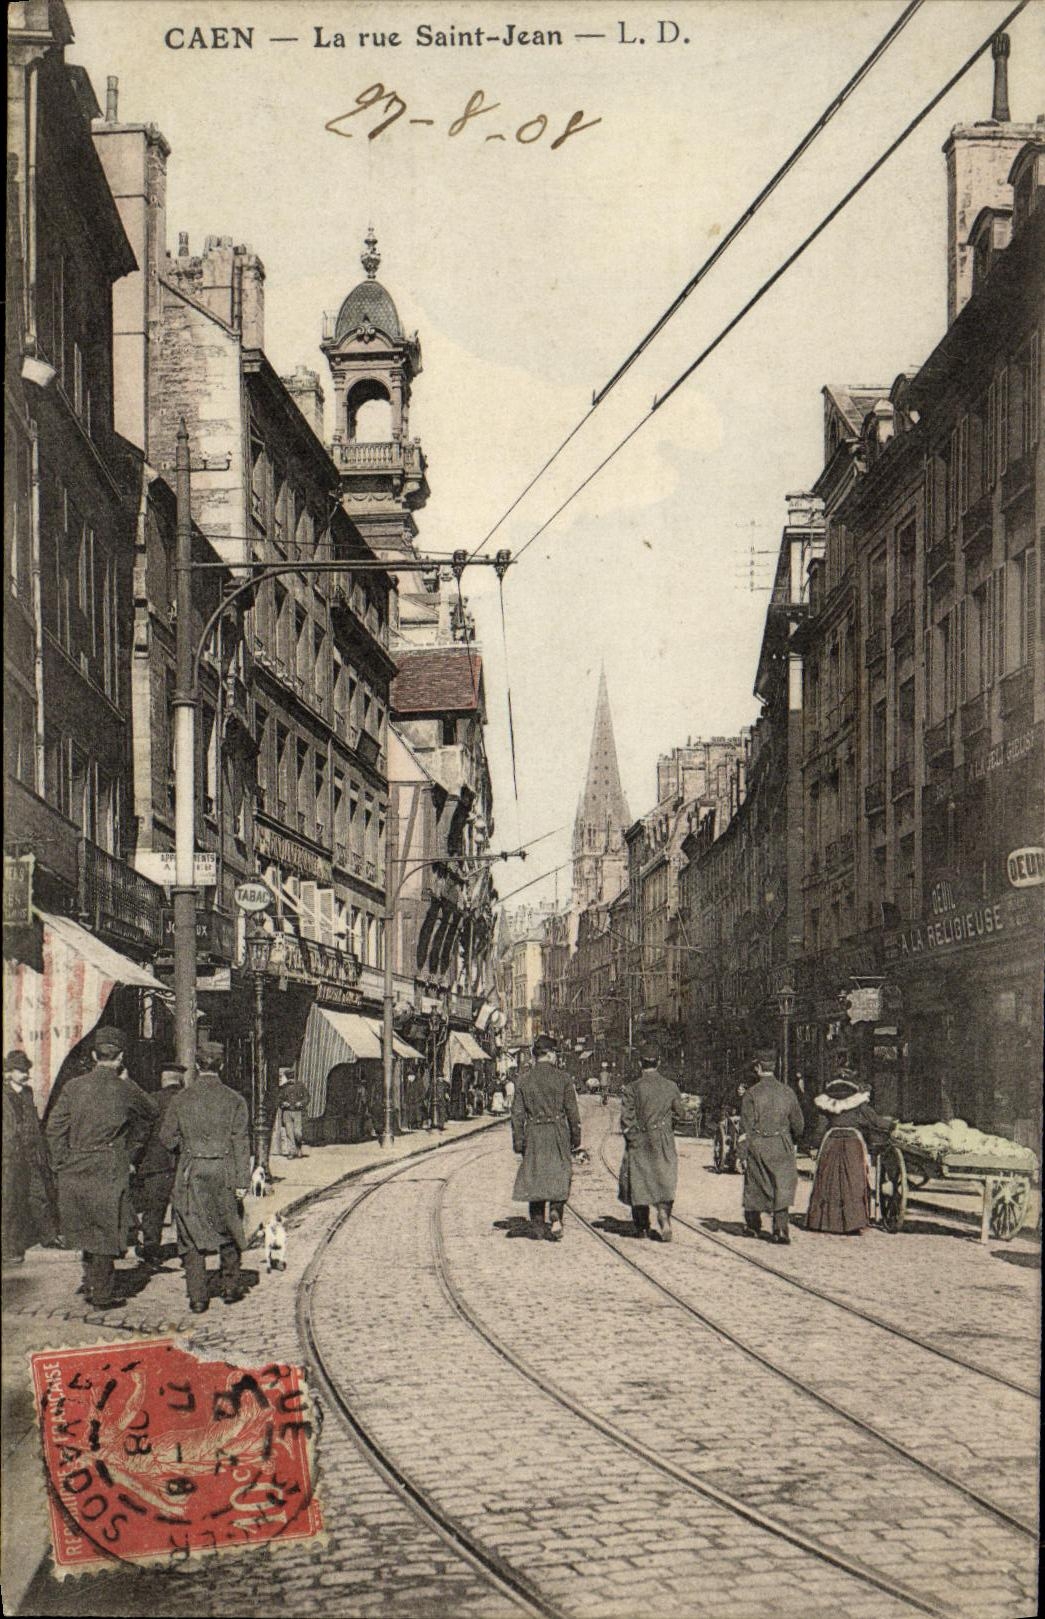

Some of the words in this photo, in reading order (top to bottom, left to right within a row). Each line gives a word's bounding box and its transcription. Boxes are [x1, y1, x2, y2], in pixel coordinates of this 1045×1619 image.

[238, 889, 268, 903] TABAC
[901, 933, 909, 957] A
[910, 928, 923, 952] LA
[927, 904, 1004, 950] RELIGIEUSE
